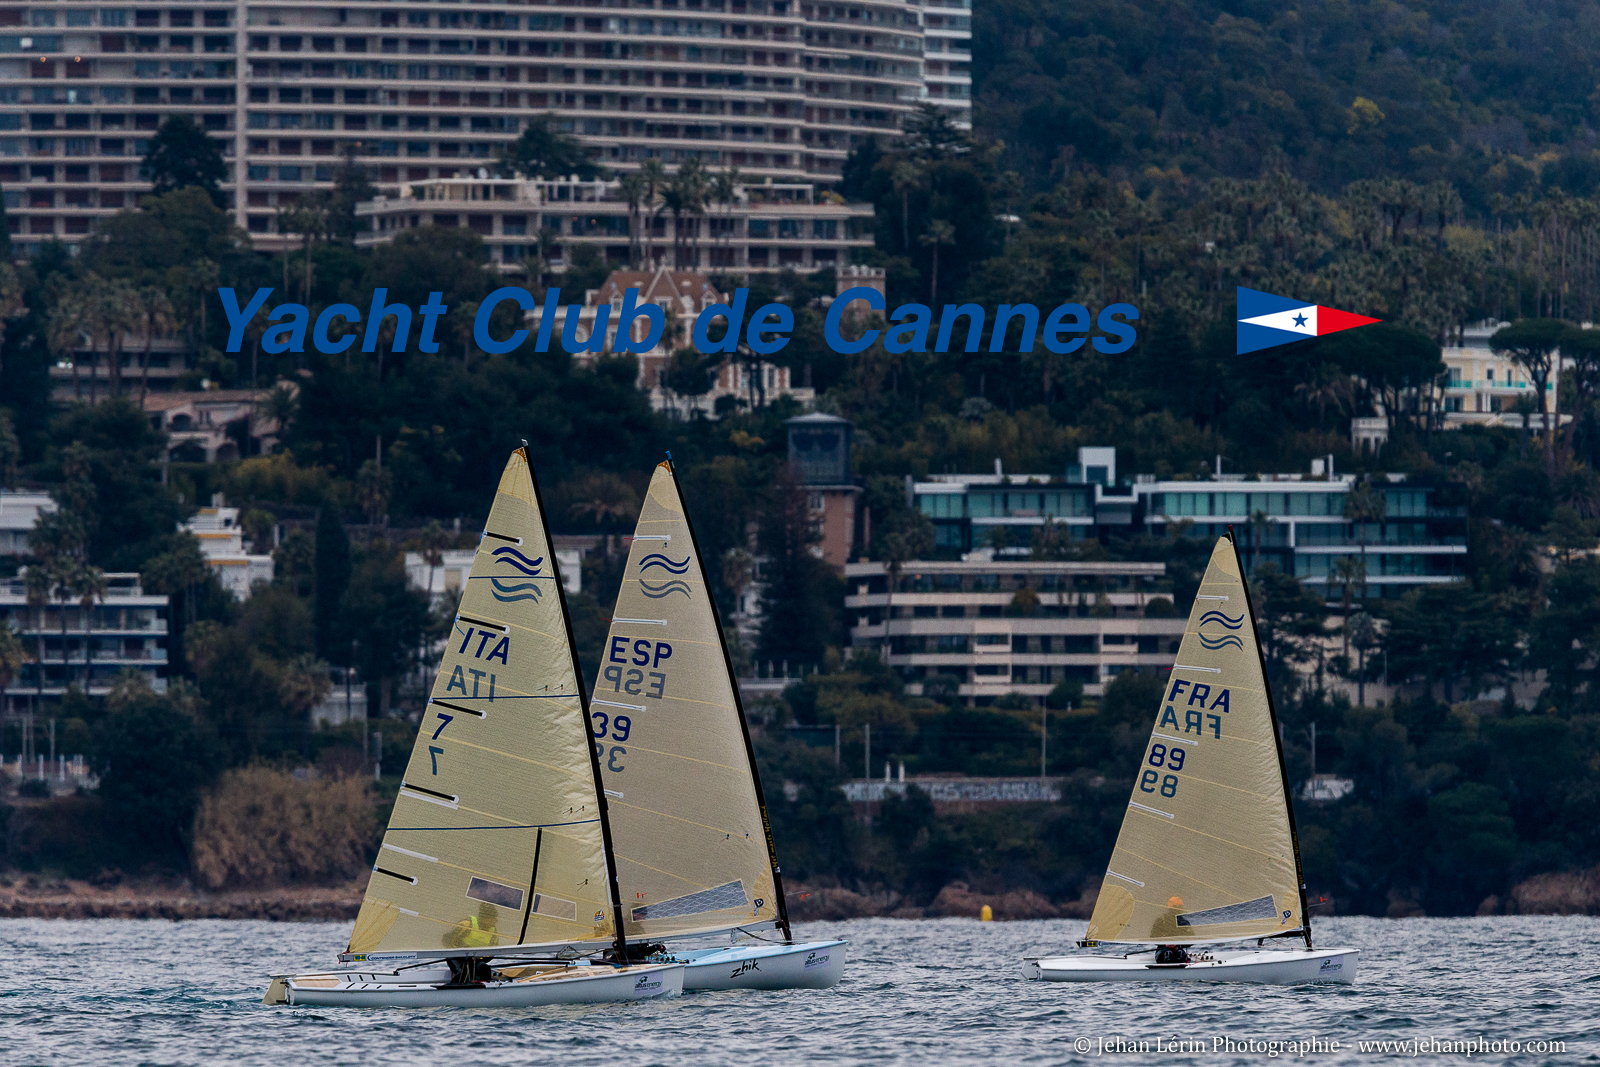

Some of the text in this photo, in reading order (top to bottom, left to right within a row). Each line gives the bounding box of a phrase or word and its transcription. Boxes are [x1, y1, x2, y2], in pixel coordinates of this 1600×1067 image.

[458, 627, 510, 665] ITA
[609, 636, 673, 668] ESP
[1167, 679, 1230, 713] FRA
[431, 712, 454, 740] 7
[591, 711, 632, 742] 39
[1148, 743, 1186, 771] 89
